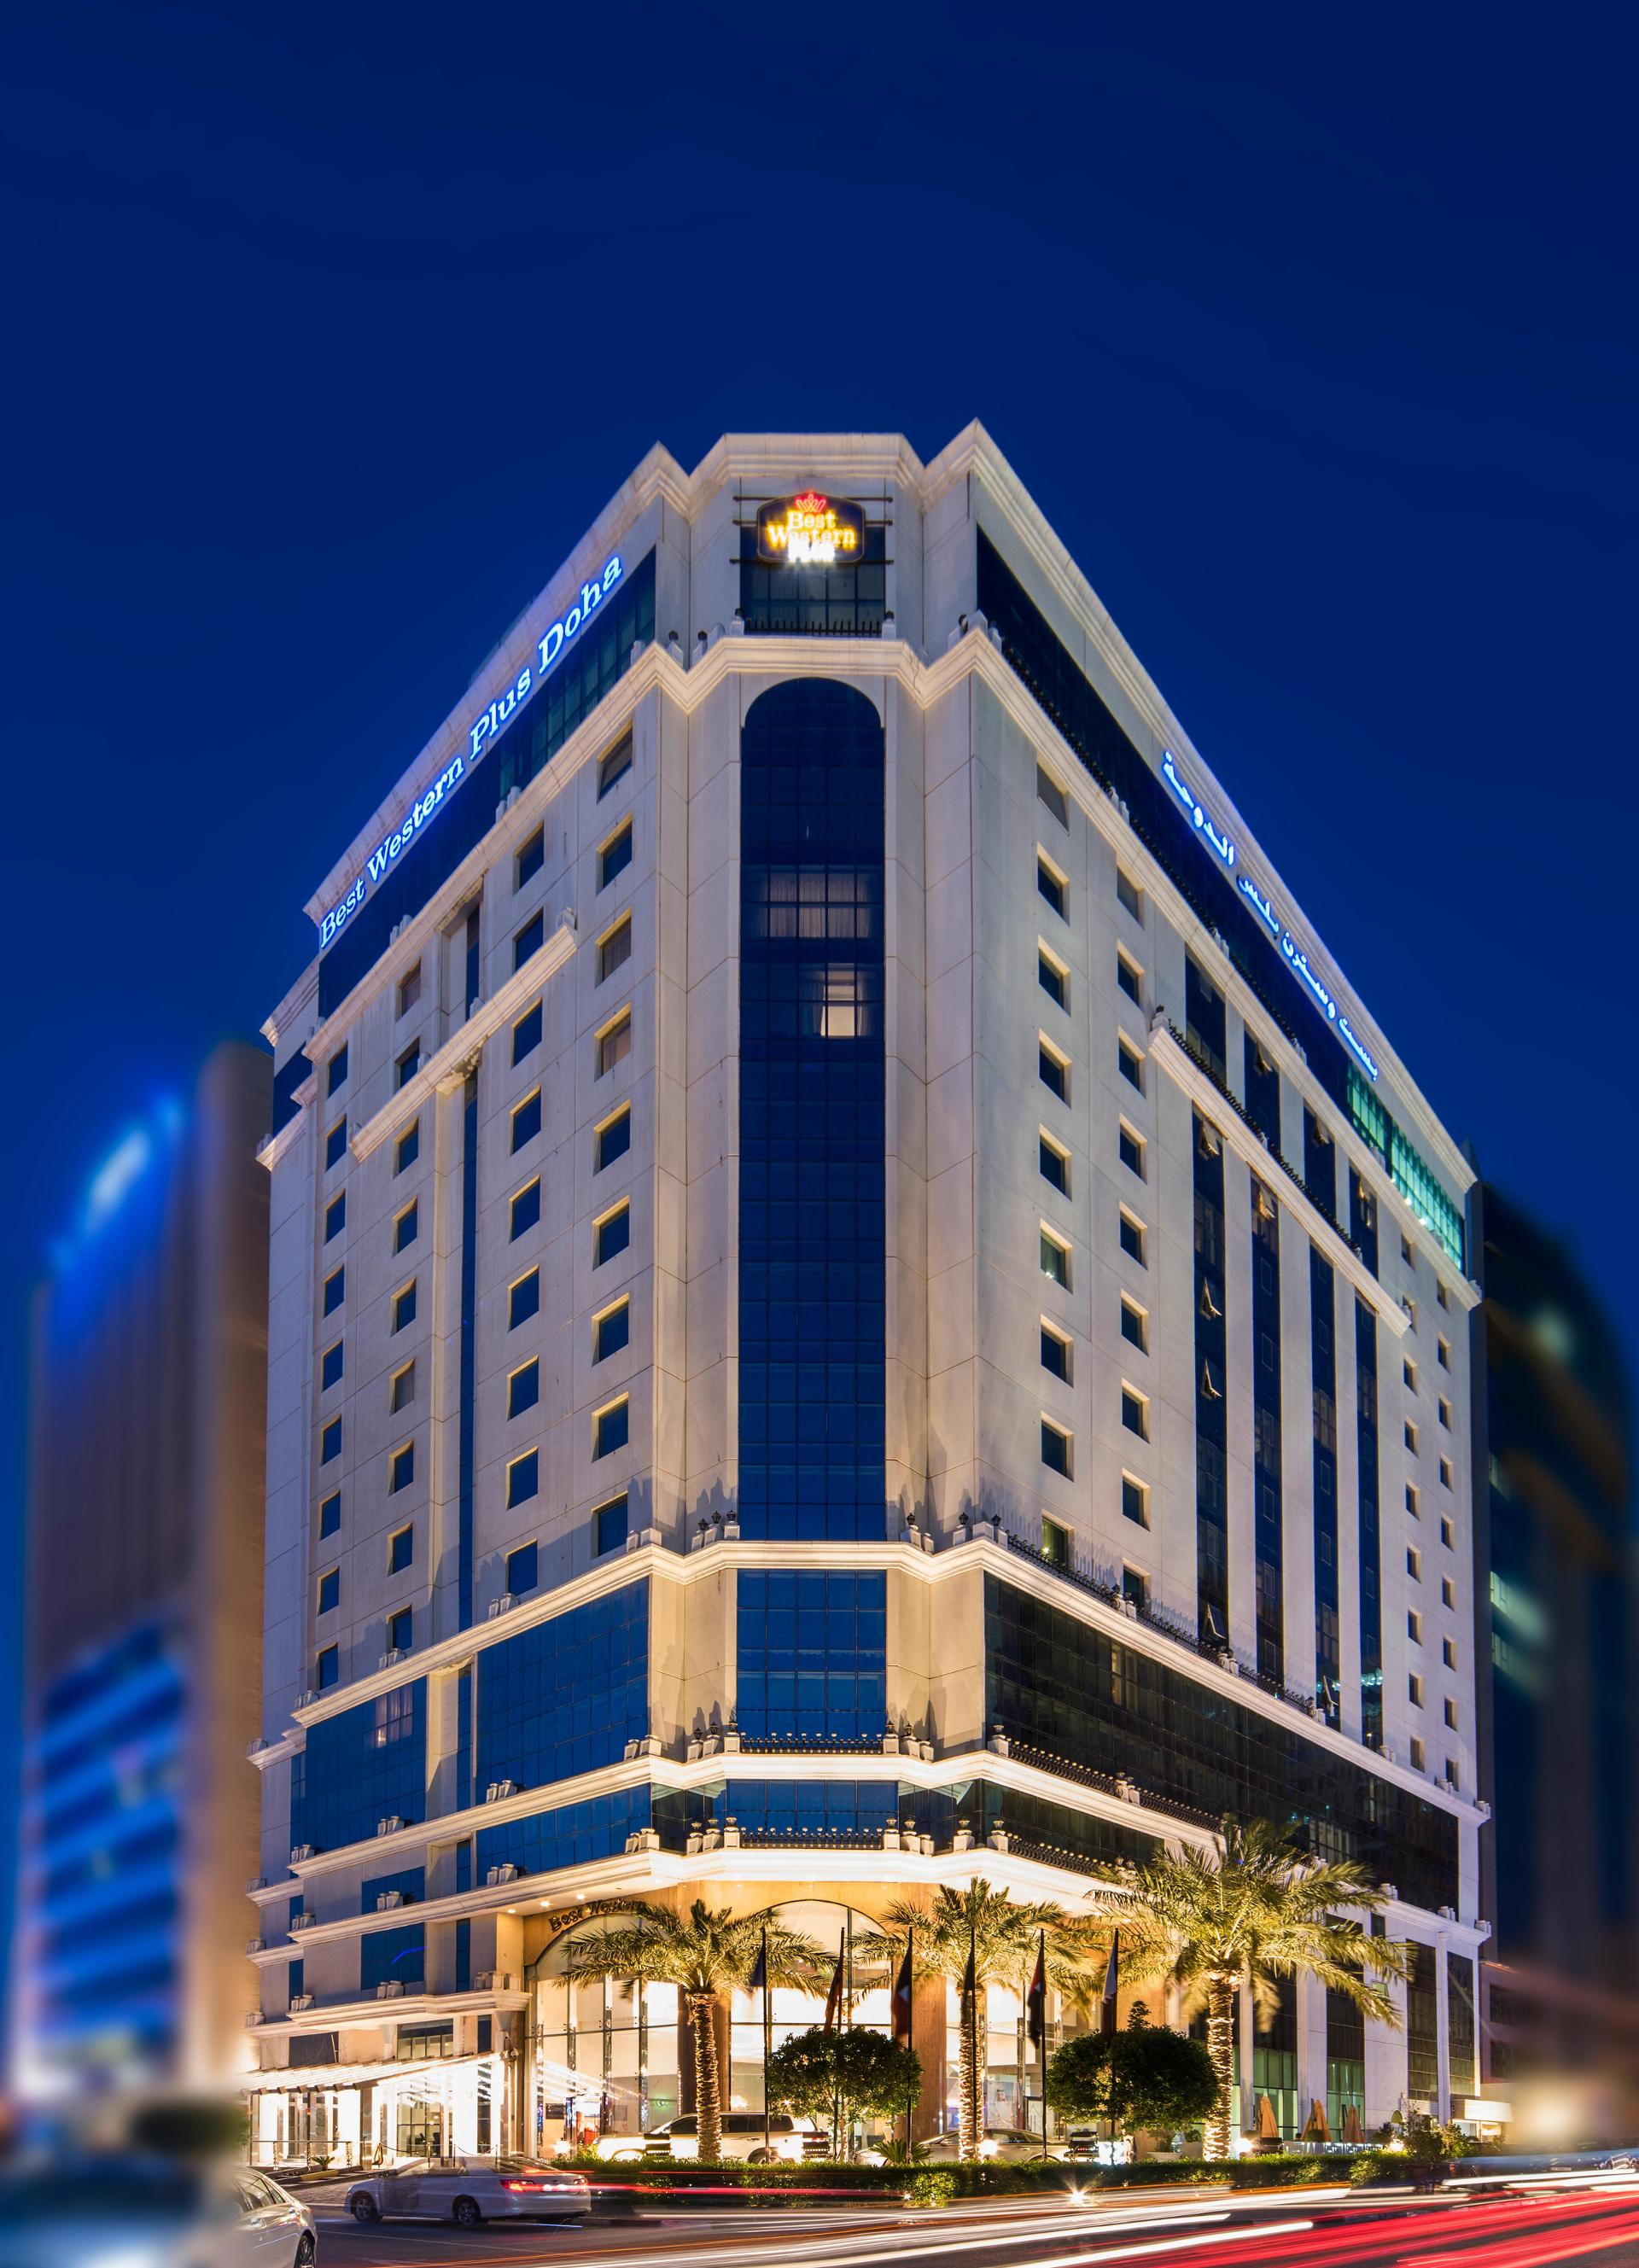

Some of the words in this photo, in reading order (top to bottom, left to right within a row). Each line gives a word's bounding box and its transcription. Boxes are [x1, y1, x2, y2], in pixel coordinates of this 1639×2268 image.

[787, 509, 837, 529] Best
[767, 524, 856, 549] Western
[320, 877, 365, 948] Best
[367, 756, 464, 881] Western
[470, 668, 530, 760] Plus
[538, 556, 622, 674] Doha
[1163, 751, 1234, 866] الدوحة
[549, 1905, 584, 1932] Best
